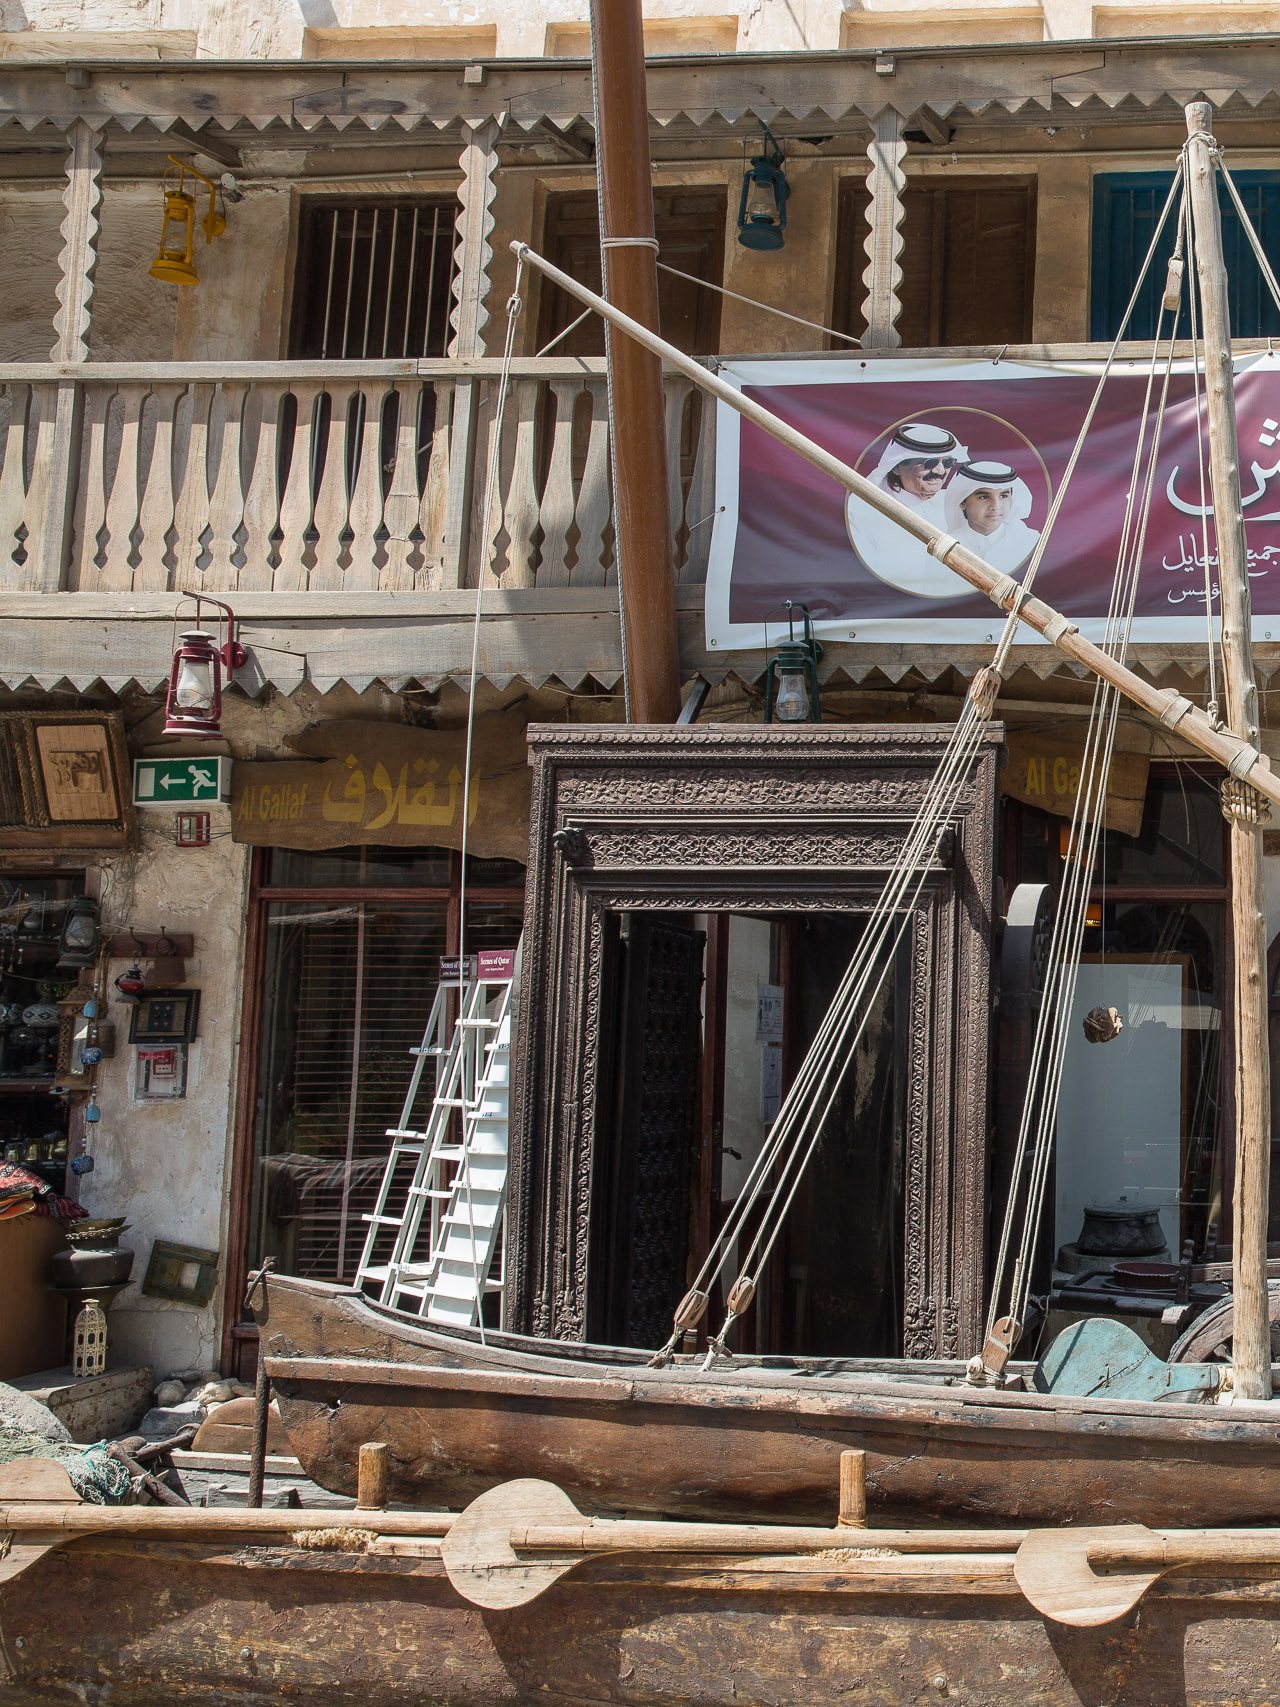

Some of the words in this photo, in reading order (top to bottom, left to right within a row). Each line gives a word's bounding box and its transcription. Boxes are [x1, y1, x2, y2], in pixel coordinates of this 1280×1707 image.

[322, 753, 481, 830] القلاف
[1025, 756, 1046, 795] Al
[237, 784, 256, 821] Al
